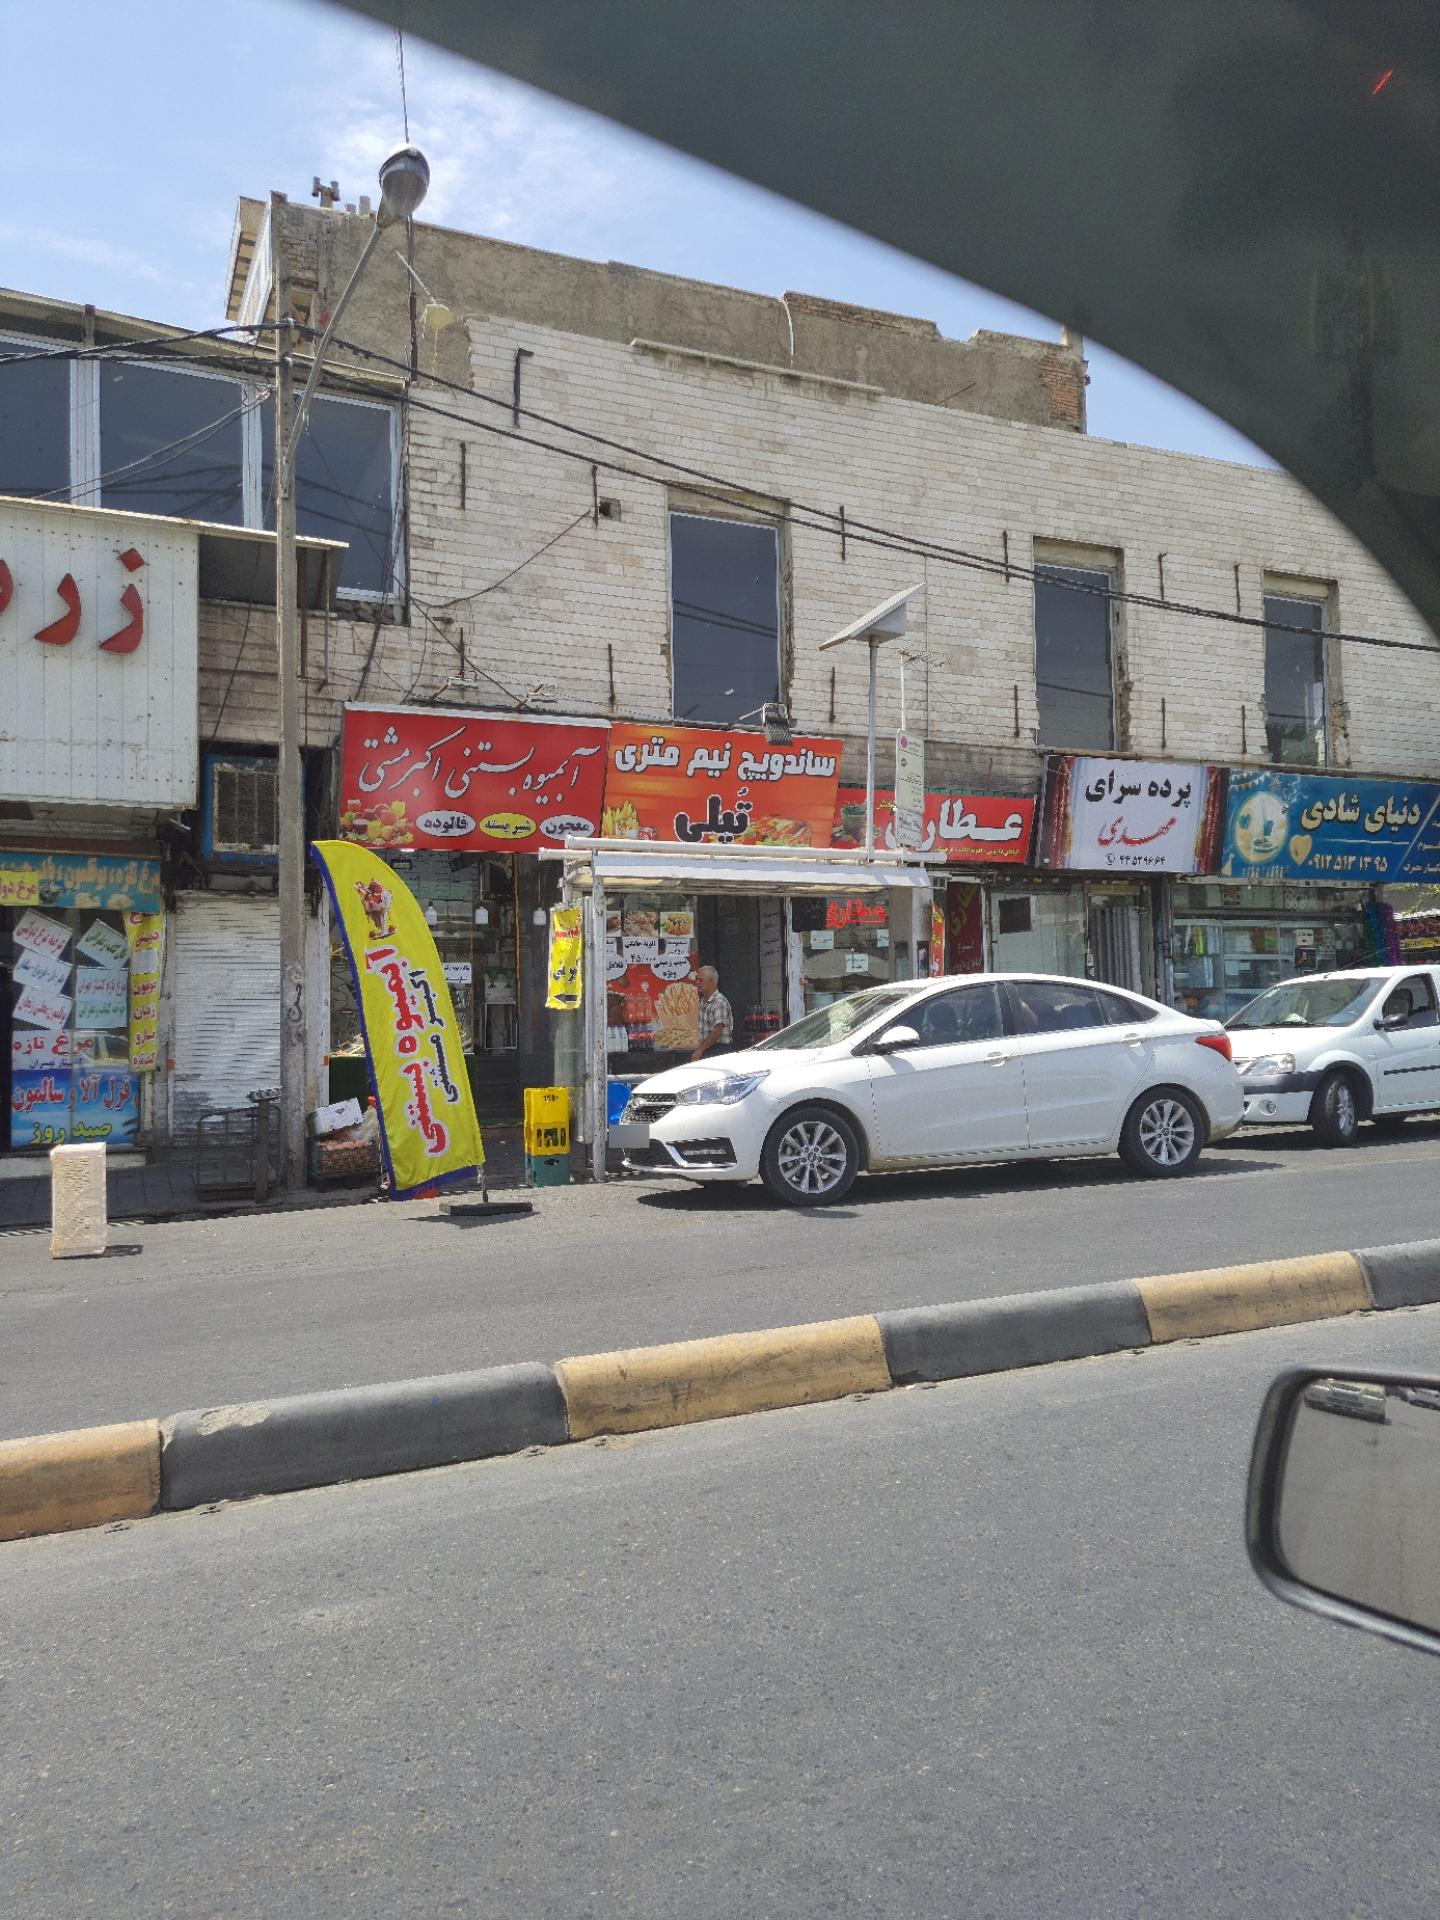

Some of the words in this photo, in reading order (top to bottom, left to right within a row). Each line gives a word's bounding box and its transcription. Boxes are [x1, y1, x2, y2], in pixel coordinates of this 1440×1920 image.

[444, 741, 535, 799] بستنی
[614, 736, 680, 773] متری
[686, 741, 732, 778] نیم
[737, 747, 836, 781] ساندویچ
[522, 745, 601, 805] آبمیوه
[1085, 769, 1142, 804] سرای
[1148, 778, 1192, 808] پرده
[424, 815, 469, 830] فالوده
[484, 820, 510, 834] پسته
[511, 820, 532, 835] شیر
[545, 820, 591, 835] معجون
[1301, 791, 1360, 830] شادی
[1364, 795, 1421, 833] دنیای
[824, 897, 888, 929] عطاری
[12, 1036, 45, 1055] تازه
[51, 1031, 94, 1057] مرغ
[408, 970, 444, 1027] اکبر
[430, 1034, 459, 1102] مشتی
[11, 1075, 65, 1112] سالمون
[80, 1074, 102, 1103] آلا
[103, 1074, 131, 1111] قزل
[403, 1060, 446, 1154] بستنی
[30, 1121, 66, 1144] روز
[72, 1121, 113, 1140] صید
